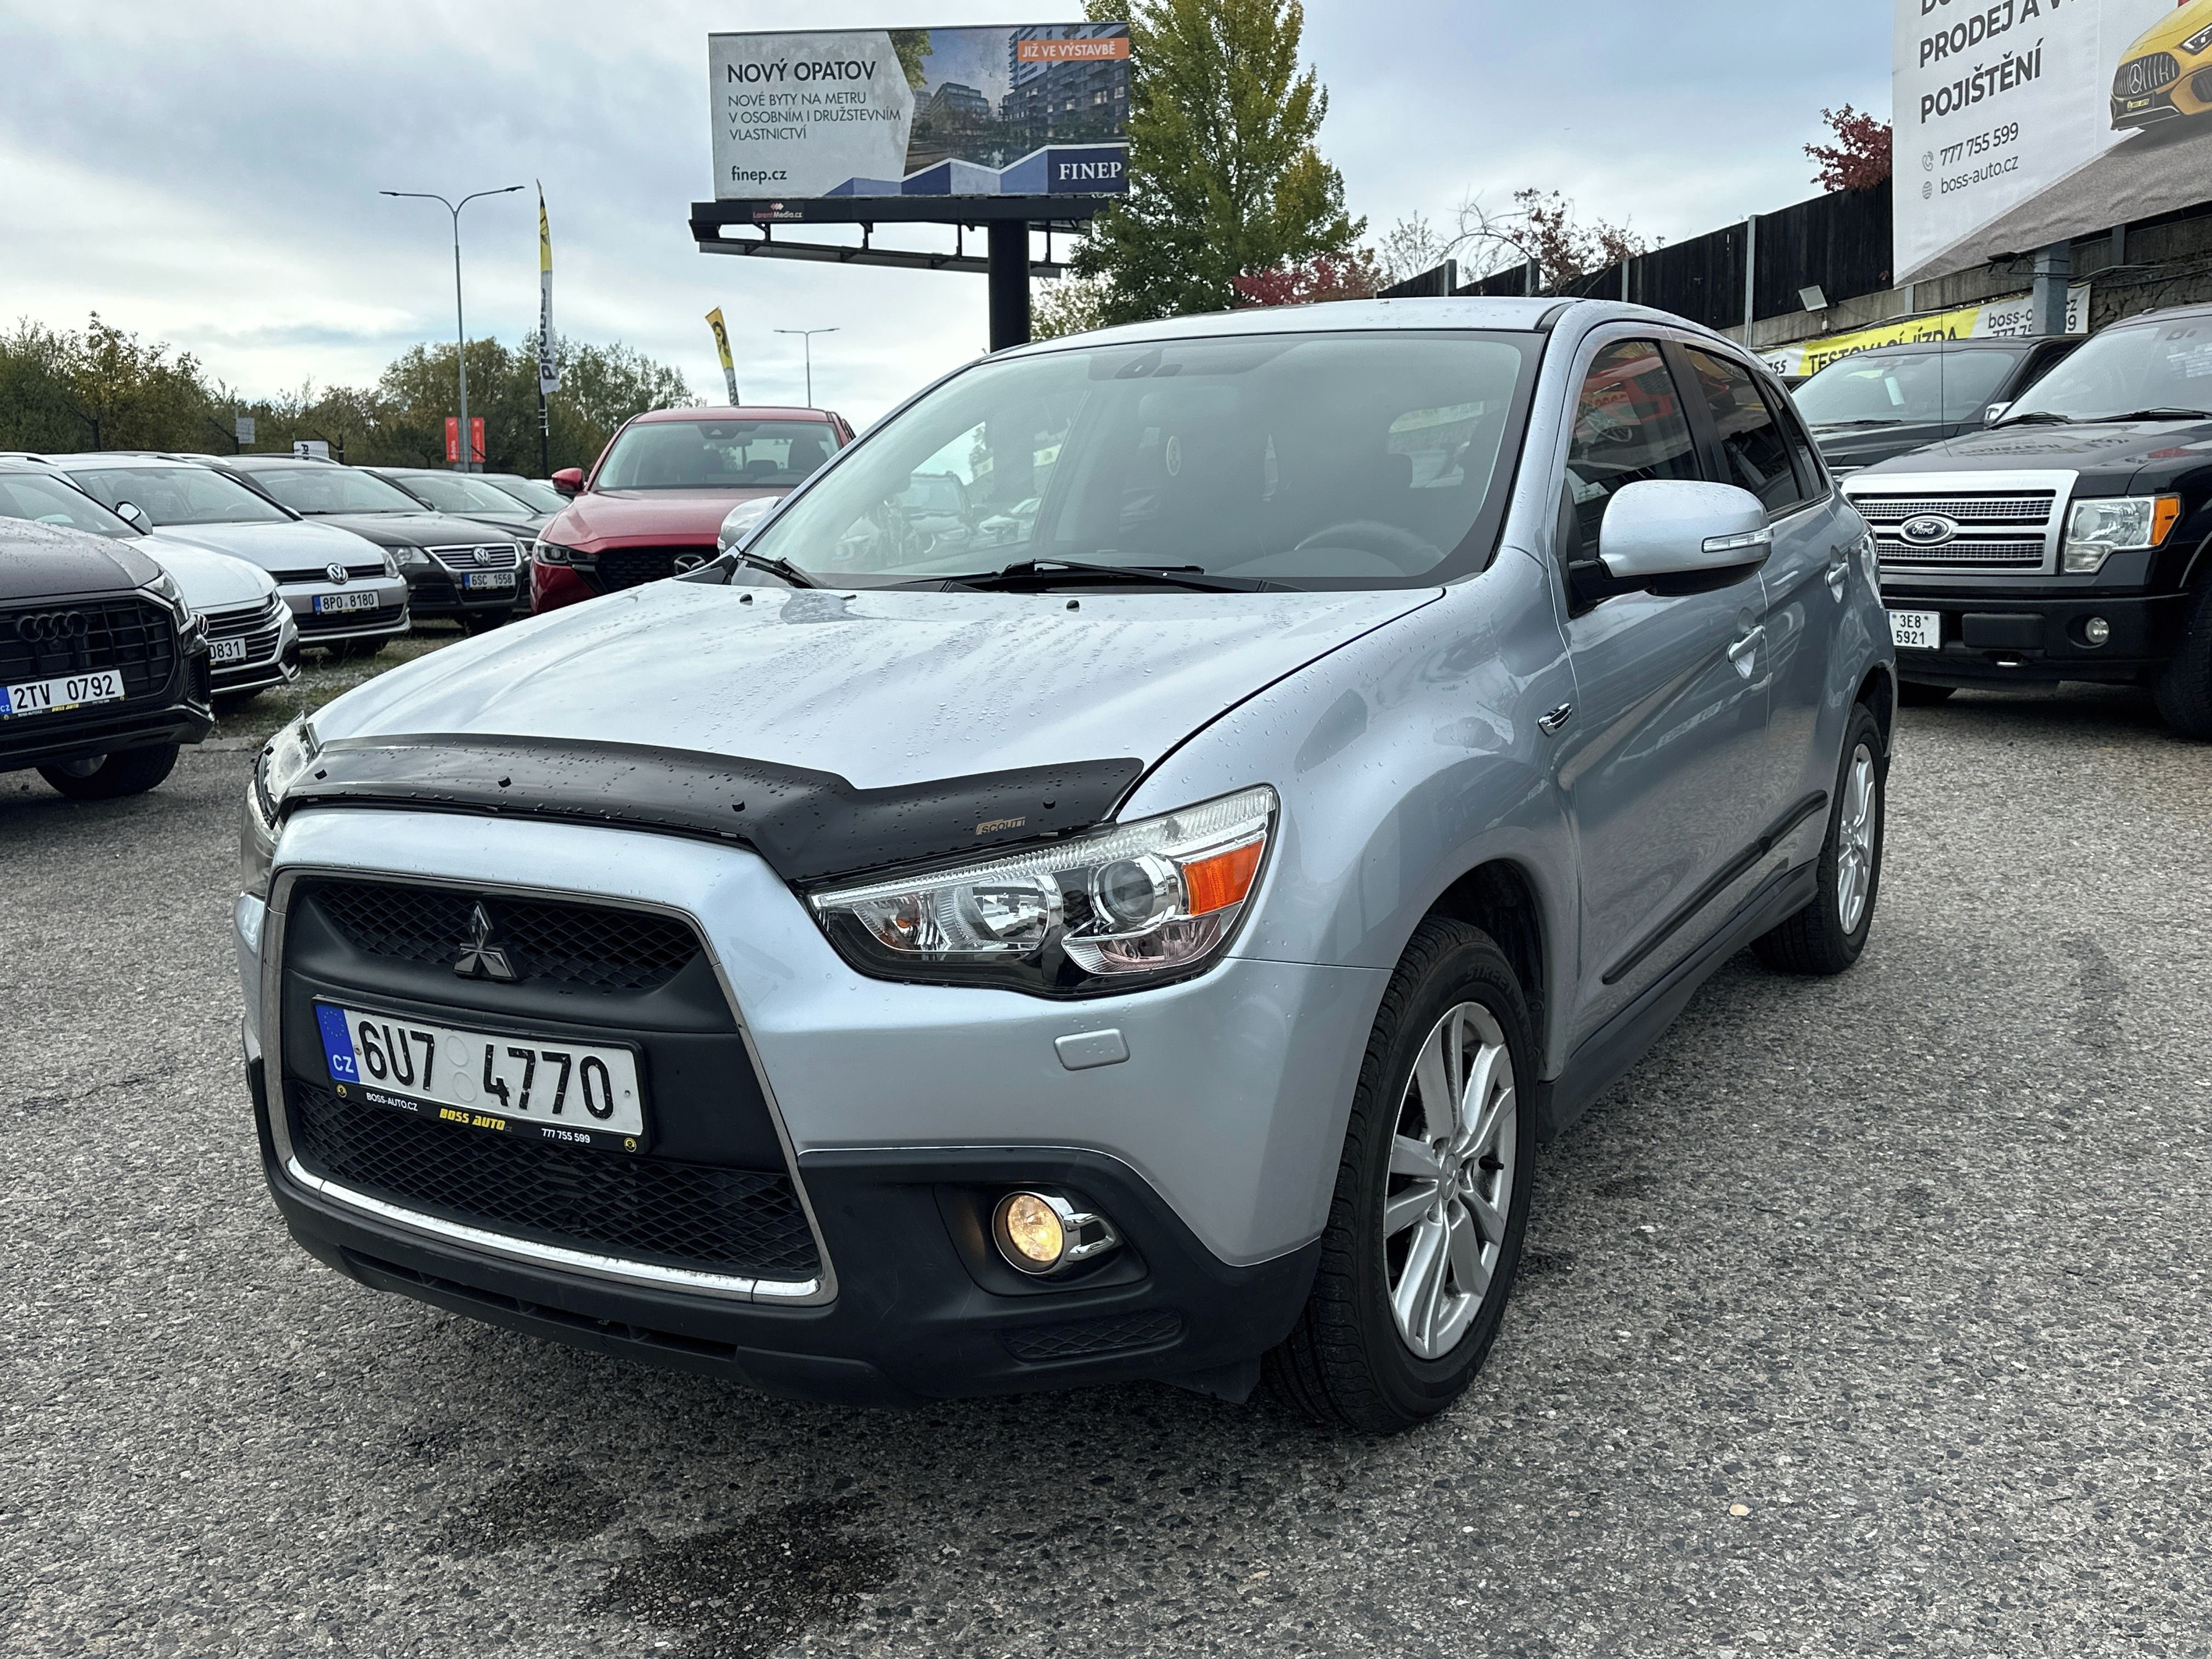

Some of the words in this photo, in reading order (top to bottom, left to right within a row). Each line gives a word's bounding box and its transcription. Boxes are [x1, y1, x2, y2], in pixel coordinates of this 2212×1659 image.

[1920, 0, 2014, 69] PRODEJ
[1023, 43, 1039, 57] JIŽ
[1042, 46, 1056, 57] VE
[1059, 41, 1115, 57] VÝSTAVBĚ
[727, 58, 788, 82] NOVÝ
[794, 61, 876, 81] OPATOV
[1921, 37, 2044, 124] POJIŠTĚNÍ
[728, 91, 765, 107] NOVÉ
[769, 93, 797, 106] BYTY
[802, 93, 822, 105] NA
[825, 92, 866, 104] METRU
[729, 112, 737, 123] V
[741, 108, 803, 123] OSOBNÍM
[807, 110, 810, 122] I
[814, 106, 901, 122] DRUŽSTEVNÍM
[730, 125, 806, 140] VLASTNICTVÍ
[1940, 142, 1963, 166] 777
[1966, 132, 1989, 157] 755
[1993, 122, 2019, 147] 599
[732, 166, 787, 185] finep.cz
[1059, 162, 1122, 180] FINEP
[1941, 156, 2018, 194] boss-auto.cz
[1912, 522, 1936, 534] Ford
[472, 575, 487, 585] 6SC
[494, 574, 512, 584] 1558
[323, 596, 343, 610] 8P0
[349, 594, 374, 607] 8180
[1900, 614, 1921, 628] 3E8
[1897, 630, 1924, 645] 5921
[14, 684, 50, 709] 2TV
[66, 675, 115, 701] 0792
[332, 1054, 354, 1073] CZ
[359, 1020, 435, 1091] 6U7
[483, 1043, 614, 1120] 4770
[366, 1092, 418, 1111] BOSS-AUTO.CZ
[439, 1108, 469, 1124] BOSS
[472, 1115, 505, 1130] AUTO
[541, 1128, 555, 1138] 777
[557, 1130, 573, 1141] 755
[574, 1133, 590, 1143] 599
